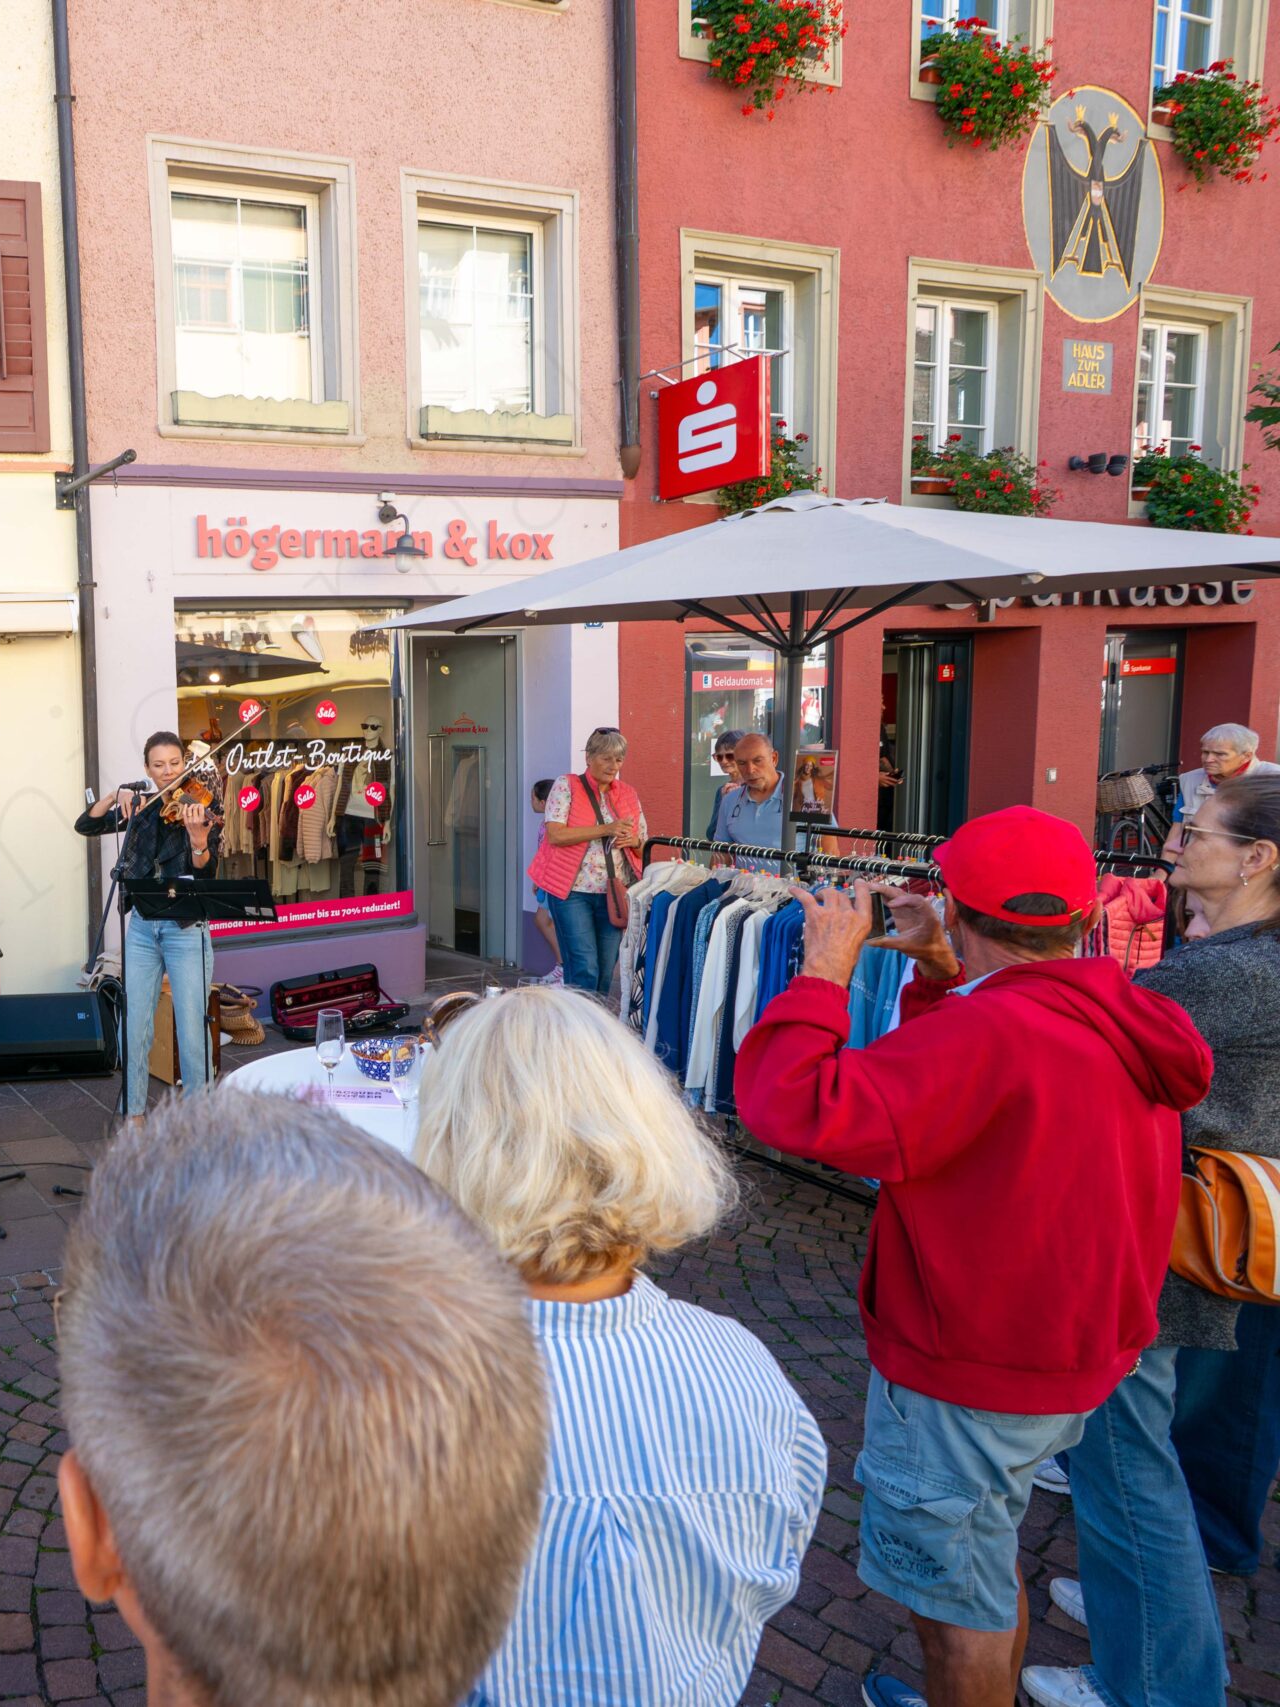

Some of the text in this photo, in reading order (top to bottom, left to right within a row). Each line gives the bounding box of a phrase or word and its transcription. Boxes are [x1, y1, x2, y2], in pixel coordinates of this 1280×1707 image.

[1073, 343, 1105, 360] HAUS
[1077, 360, 1099, 372] ZUM
[1068, 371, 1105, 389] ADLER
[444, 520, 478, 566] &
[488, 520, 554, 559] kox
[713, 676, 763, 687] Geldautomat
[241, 704, 260, 722] Sale
[317, 707, 336, 719] Sale
[225, 739, 392, 776] Outlet-Boutique
[240, 791, 259, 809] Sale
[297, 790, 315, 805] Sale
[366, 786, 384, 802] Sale
[289, 911, 315, 922] immer
[317, 909, 329, 918] bis
[342, 907, 360, 917] 70%
[362, 900, 401, 913] reduziert!
